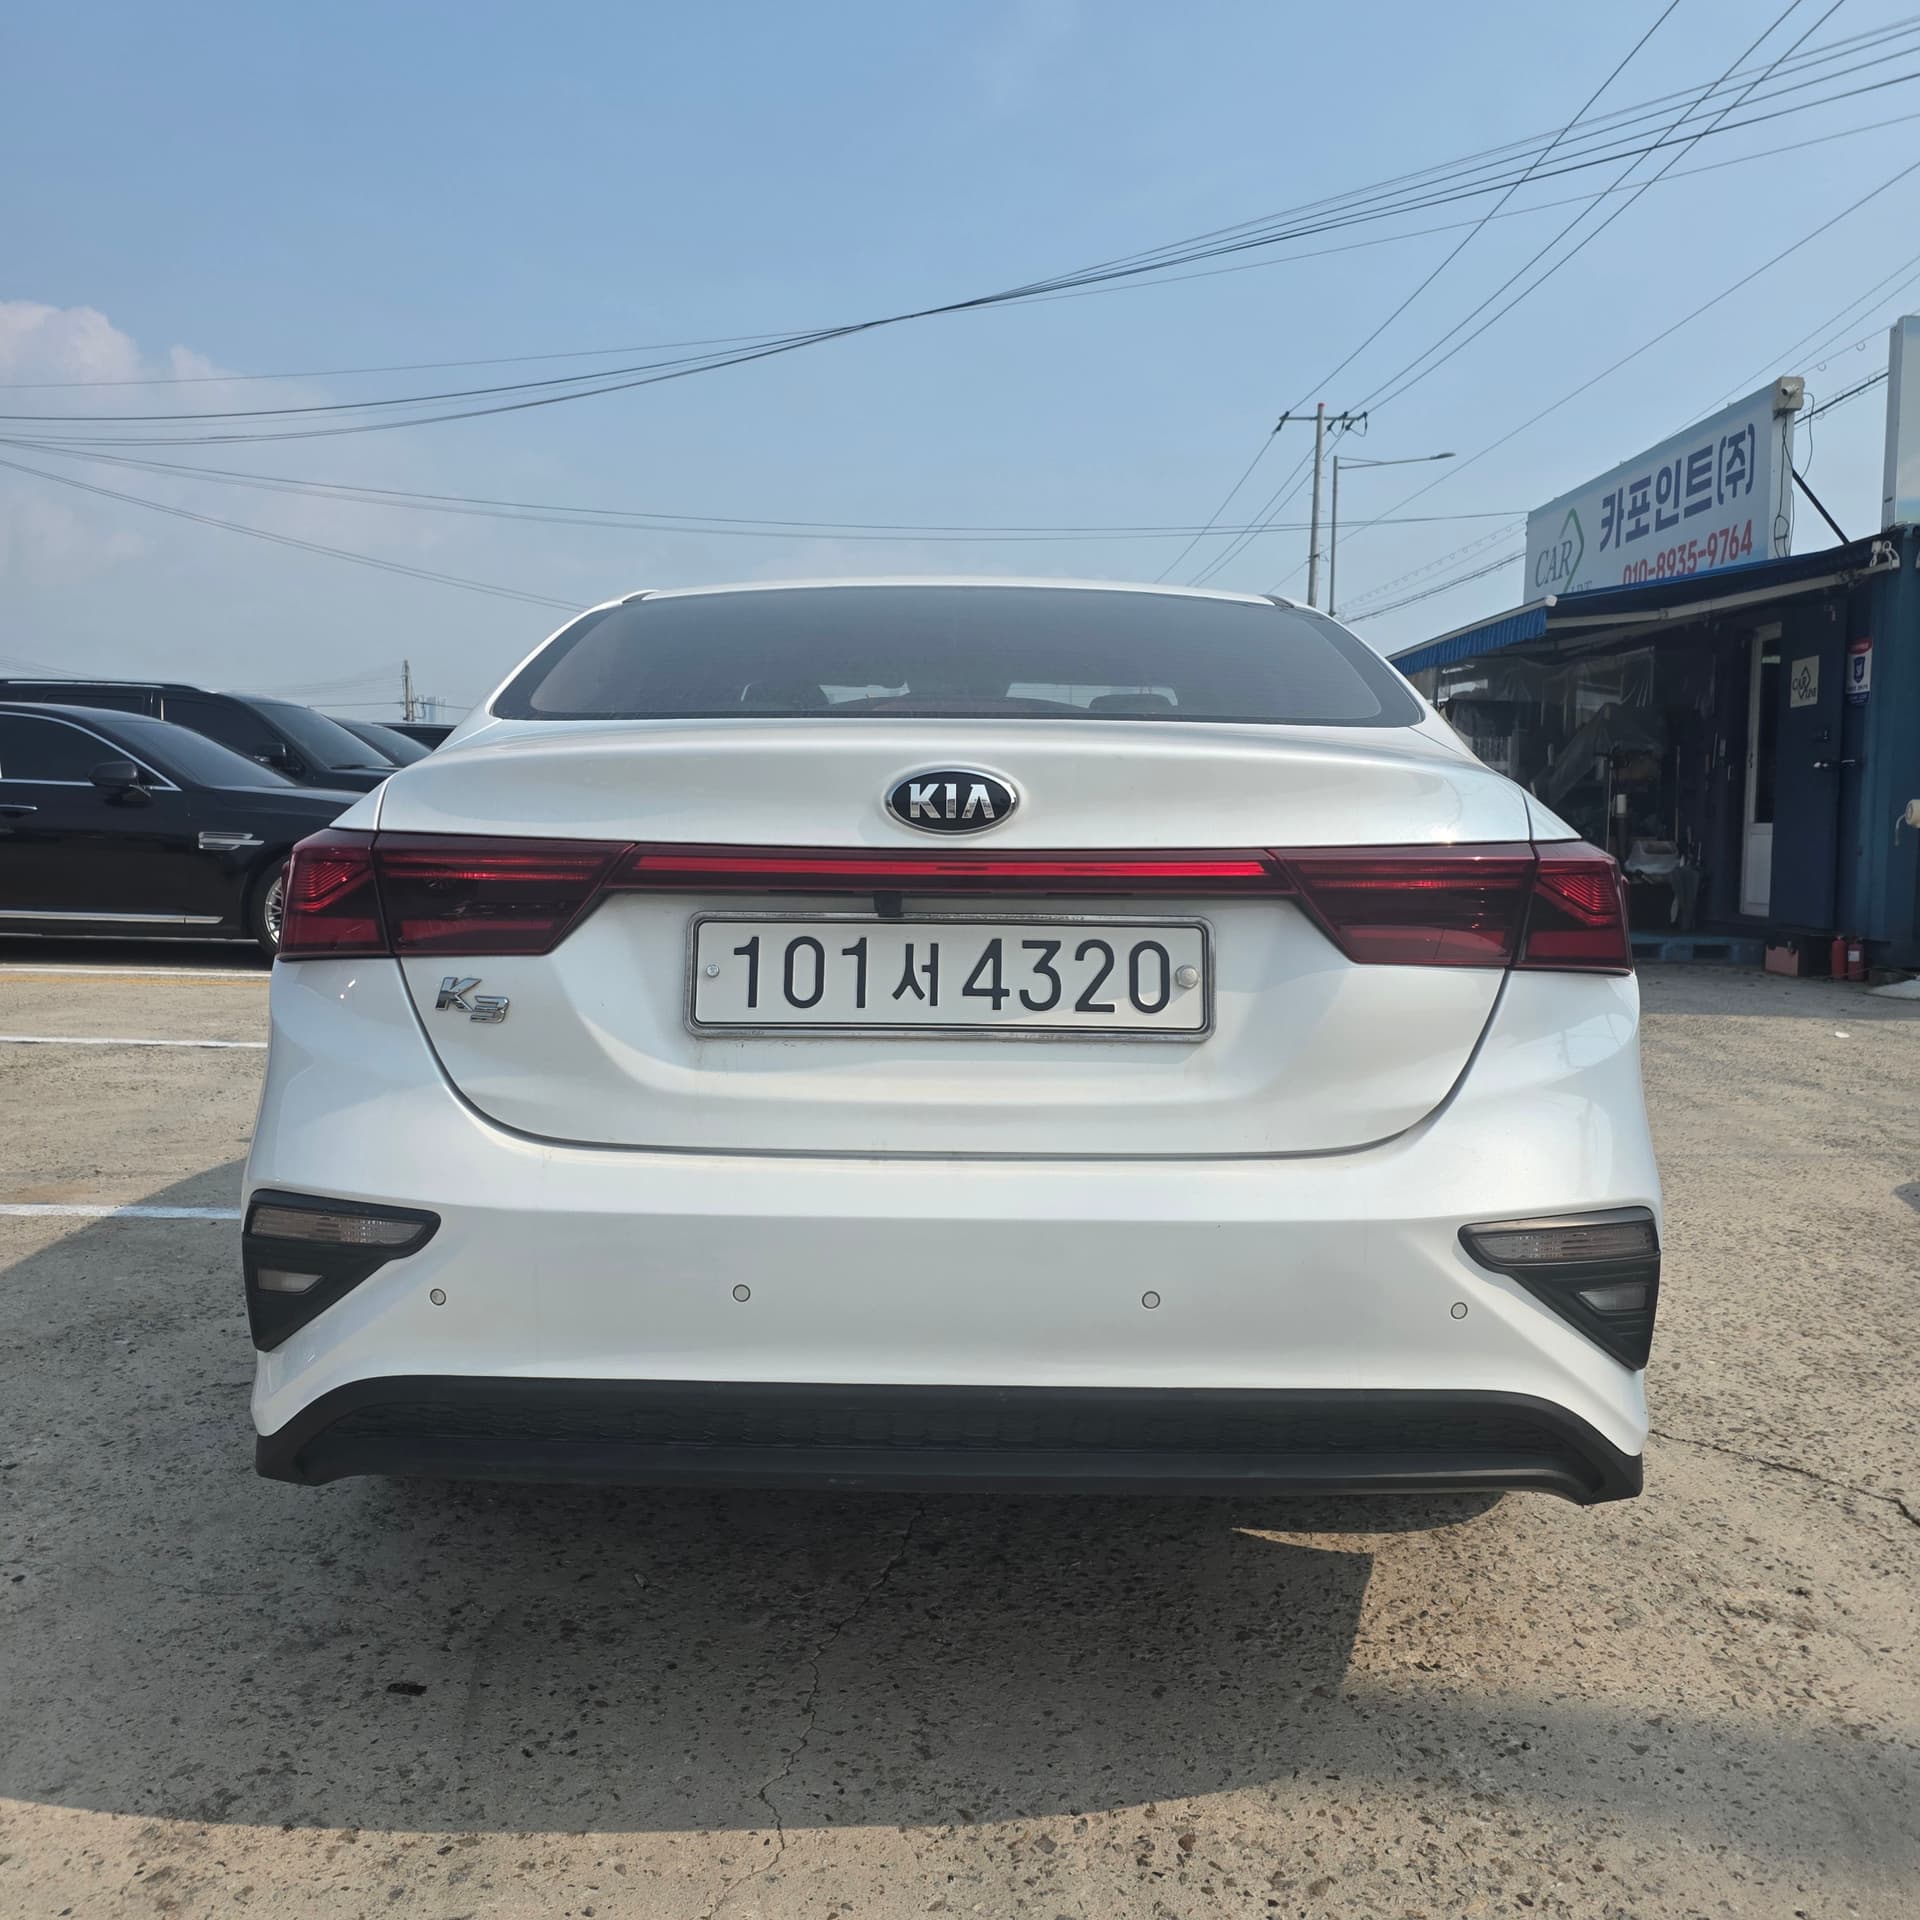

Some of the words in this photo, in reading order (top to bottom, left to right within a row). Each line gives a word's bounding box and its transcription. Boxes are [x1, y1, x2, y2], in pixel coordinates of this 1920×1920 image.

[1600, 423, 1755, 552] 카포인트(주)
[1535, 540, 1573, 588] CAR
[1623, 519, 1753, 585] 010-8935-9764
[908, 783, 996, 819] KIA
[435, 976, 509, 1024] K3
[733, 935, 1171, 1015] 101서4320
